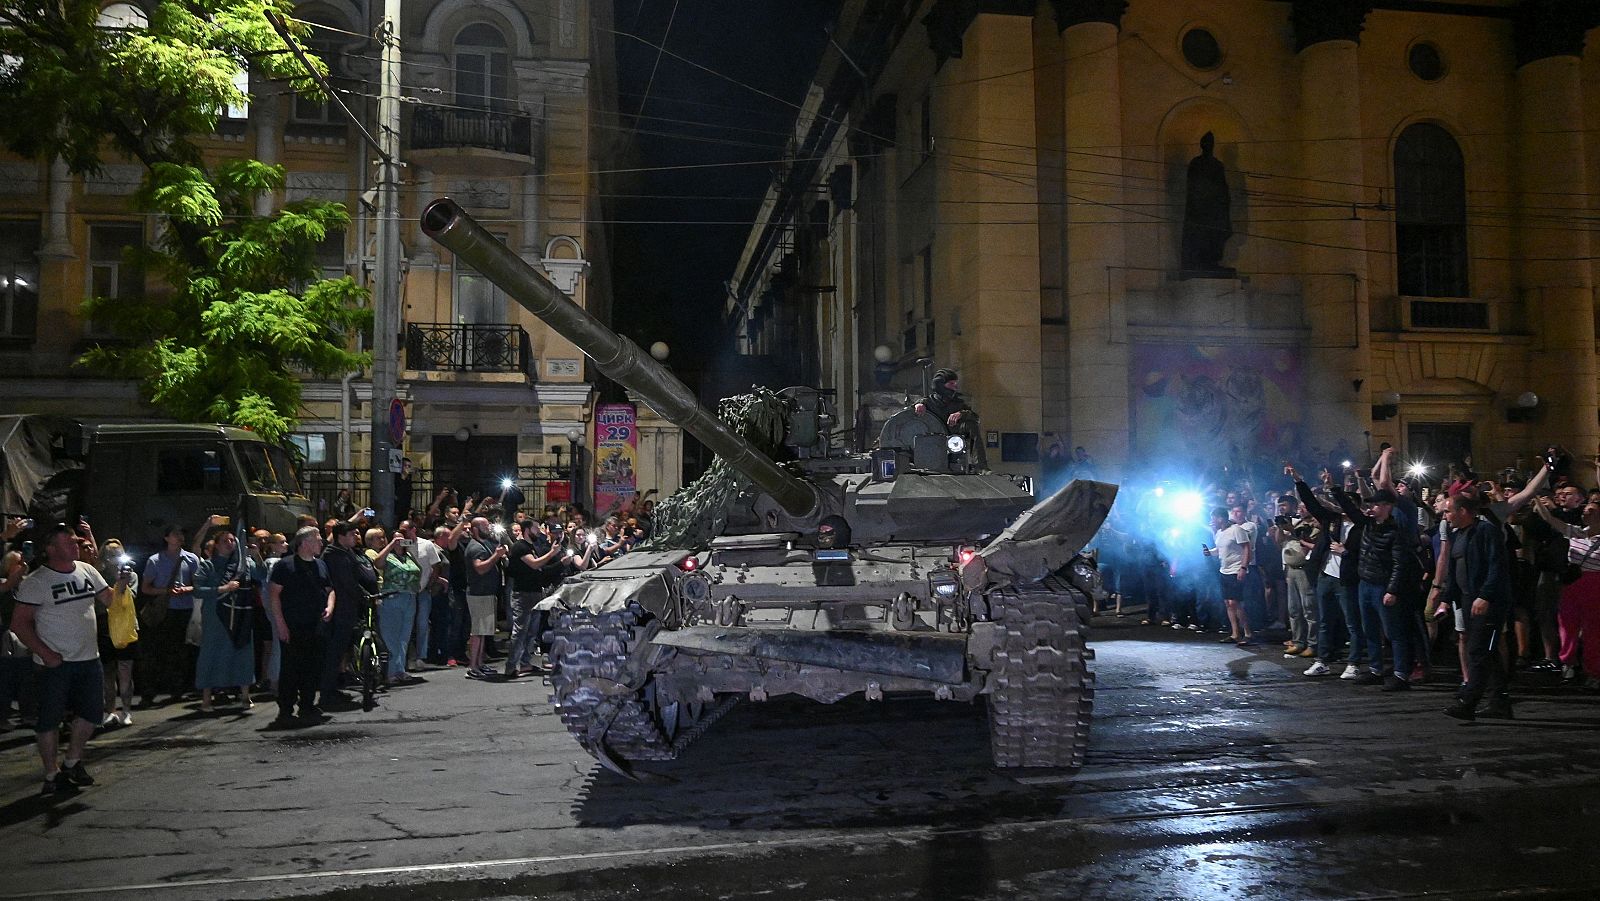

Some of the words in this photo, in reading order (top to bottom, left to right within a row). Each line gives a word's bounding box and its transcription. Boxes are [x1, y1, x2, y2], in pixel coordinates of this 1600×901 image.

[598, 413, 634, 425] ЦИРК
[607, 425, 631, 440] 29
[51, 579, 96, 599] FILA
